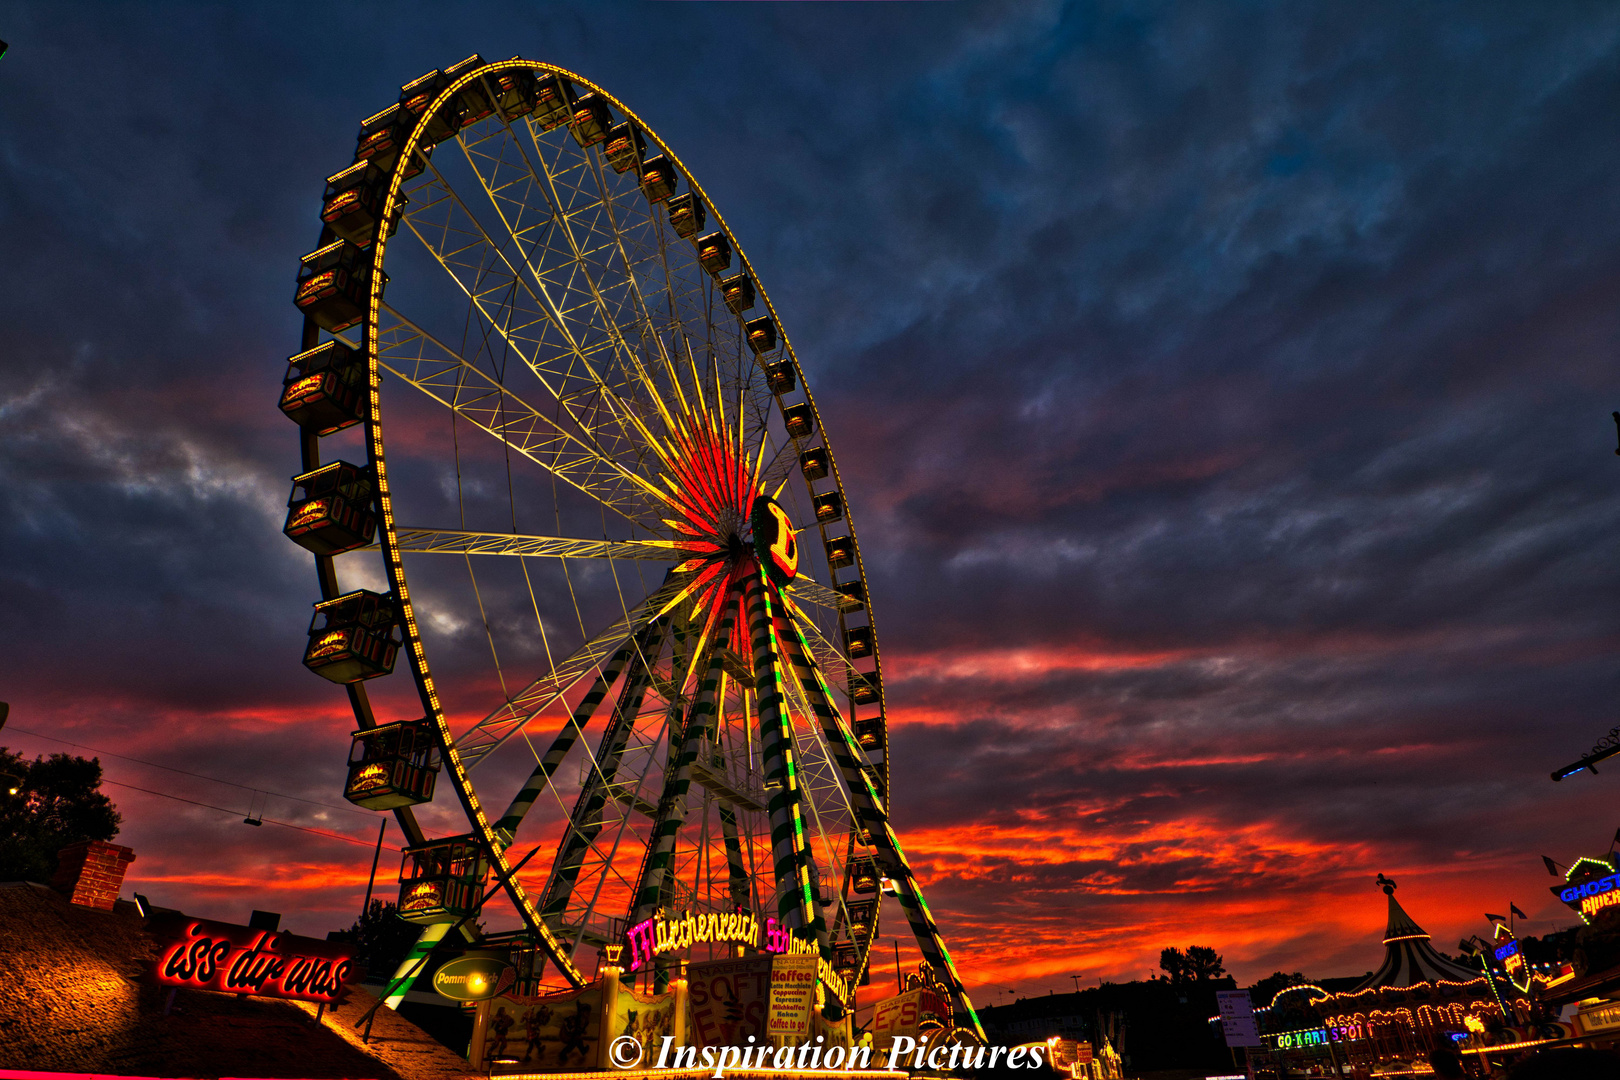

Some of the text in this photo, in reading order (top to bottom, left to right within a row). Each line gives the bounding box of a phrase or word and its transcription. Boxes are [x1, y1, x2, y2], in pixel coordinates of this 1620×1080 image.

[1560, 873, 1620, 903] GHOST
[1582, 889, 1620, 916] RIDER
[164, 924, 352, 997] iss dir was
[1494, 940, 1519, 961] GHOST
[771, 970, 813, 982] Kaffee
[690, 972, 769, 1006] SOFT
[773, 989, 807, 997] Cappuccino
[770, 1018, 805, 1032] Coffee to go
[1277, 1029, 1327, 1048] GO-KART
